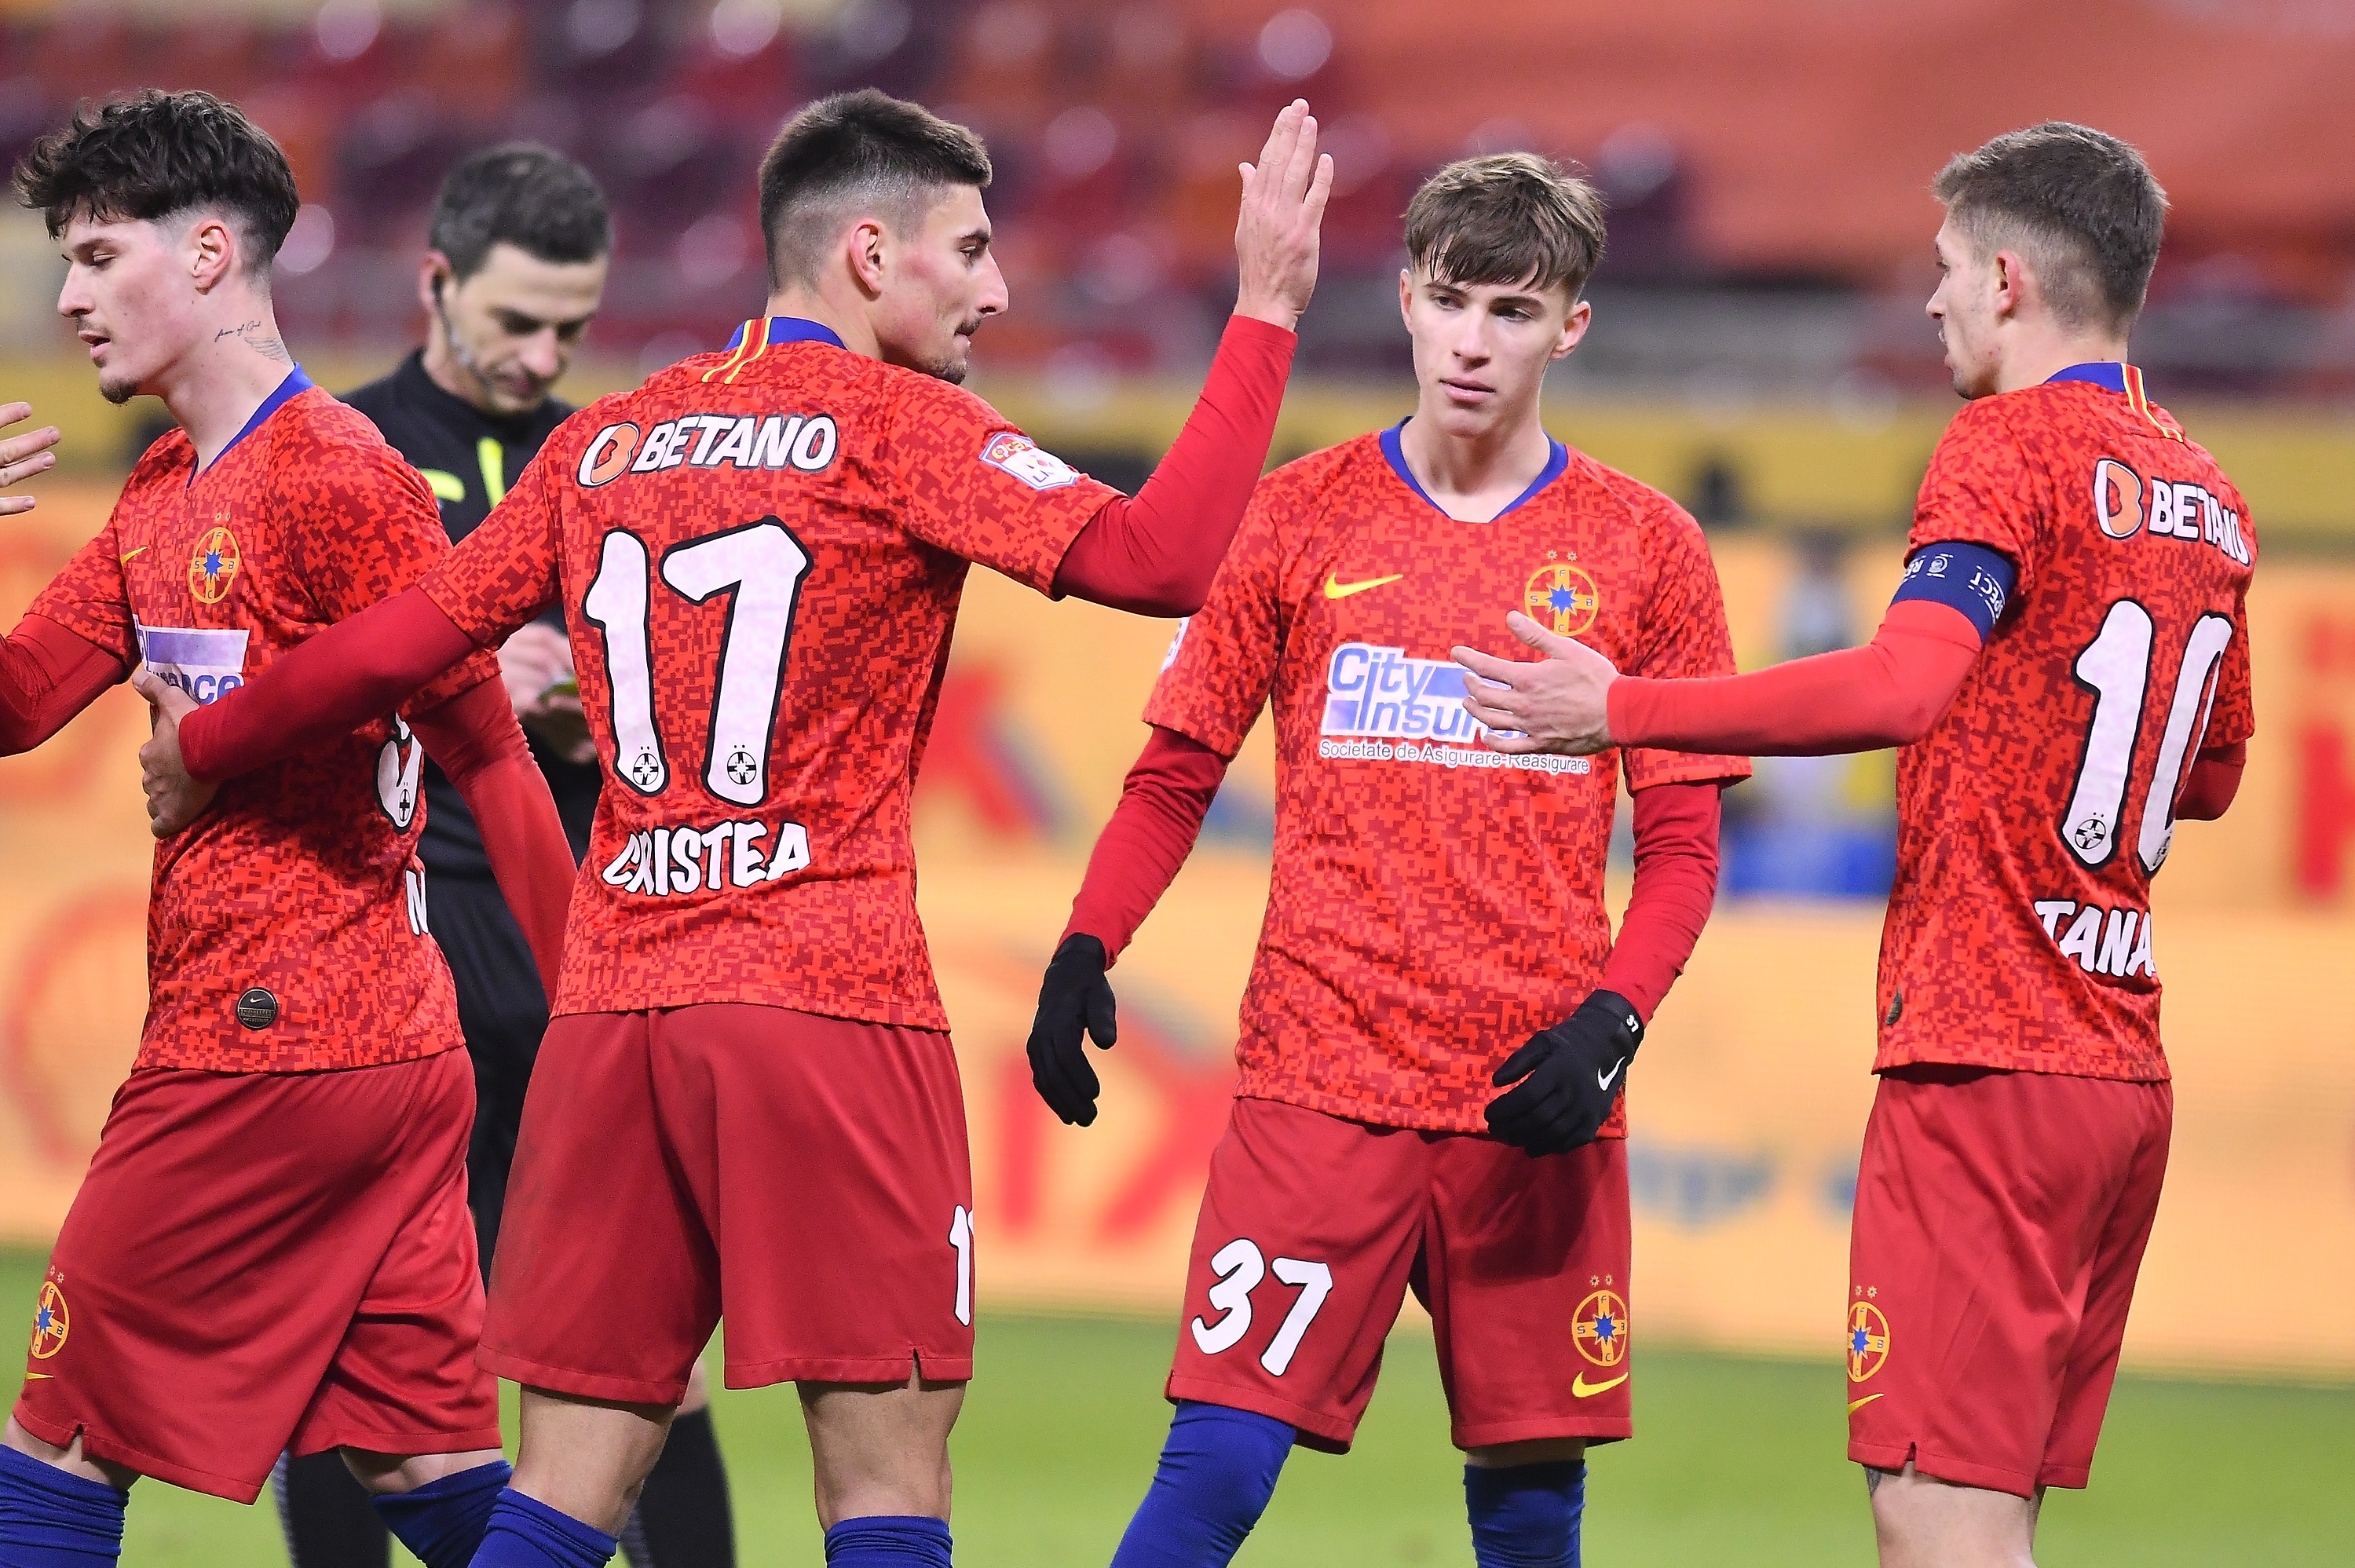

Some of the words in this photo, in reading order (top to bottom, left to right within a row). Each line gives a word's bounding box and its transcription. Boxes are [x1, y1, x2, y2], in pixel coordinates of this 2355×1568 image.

[631, 414, 838, 473] BETANO
[2148, 476, 2251, 567] BETANO
[583, 516, 814, 809] 17
[1332, 647, 1434, 706] City
[1320, 741, 1391, 758] Societate
[1397, 744, 1417, 759] de
[1422, 744, 1589, 773] Asigurare-Reasigurare
[2034, 900, 2156, 978] TANA
[1626, 1014, 1639, 1033] 37
[948, 1204, 975, 1327] 1
[1190, 1237, 1333, 1376] 37
